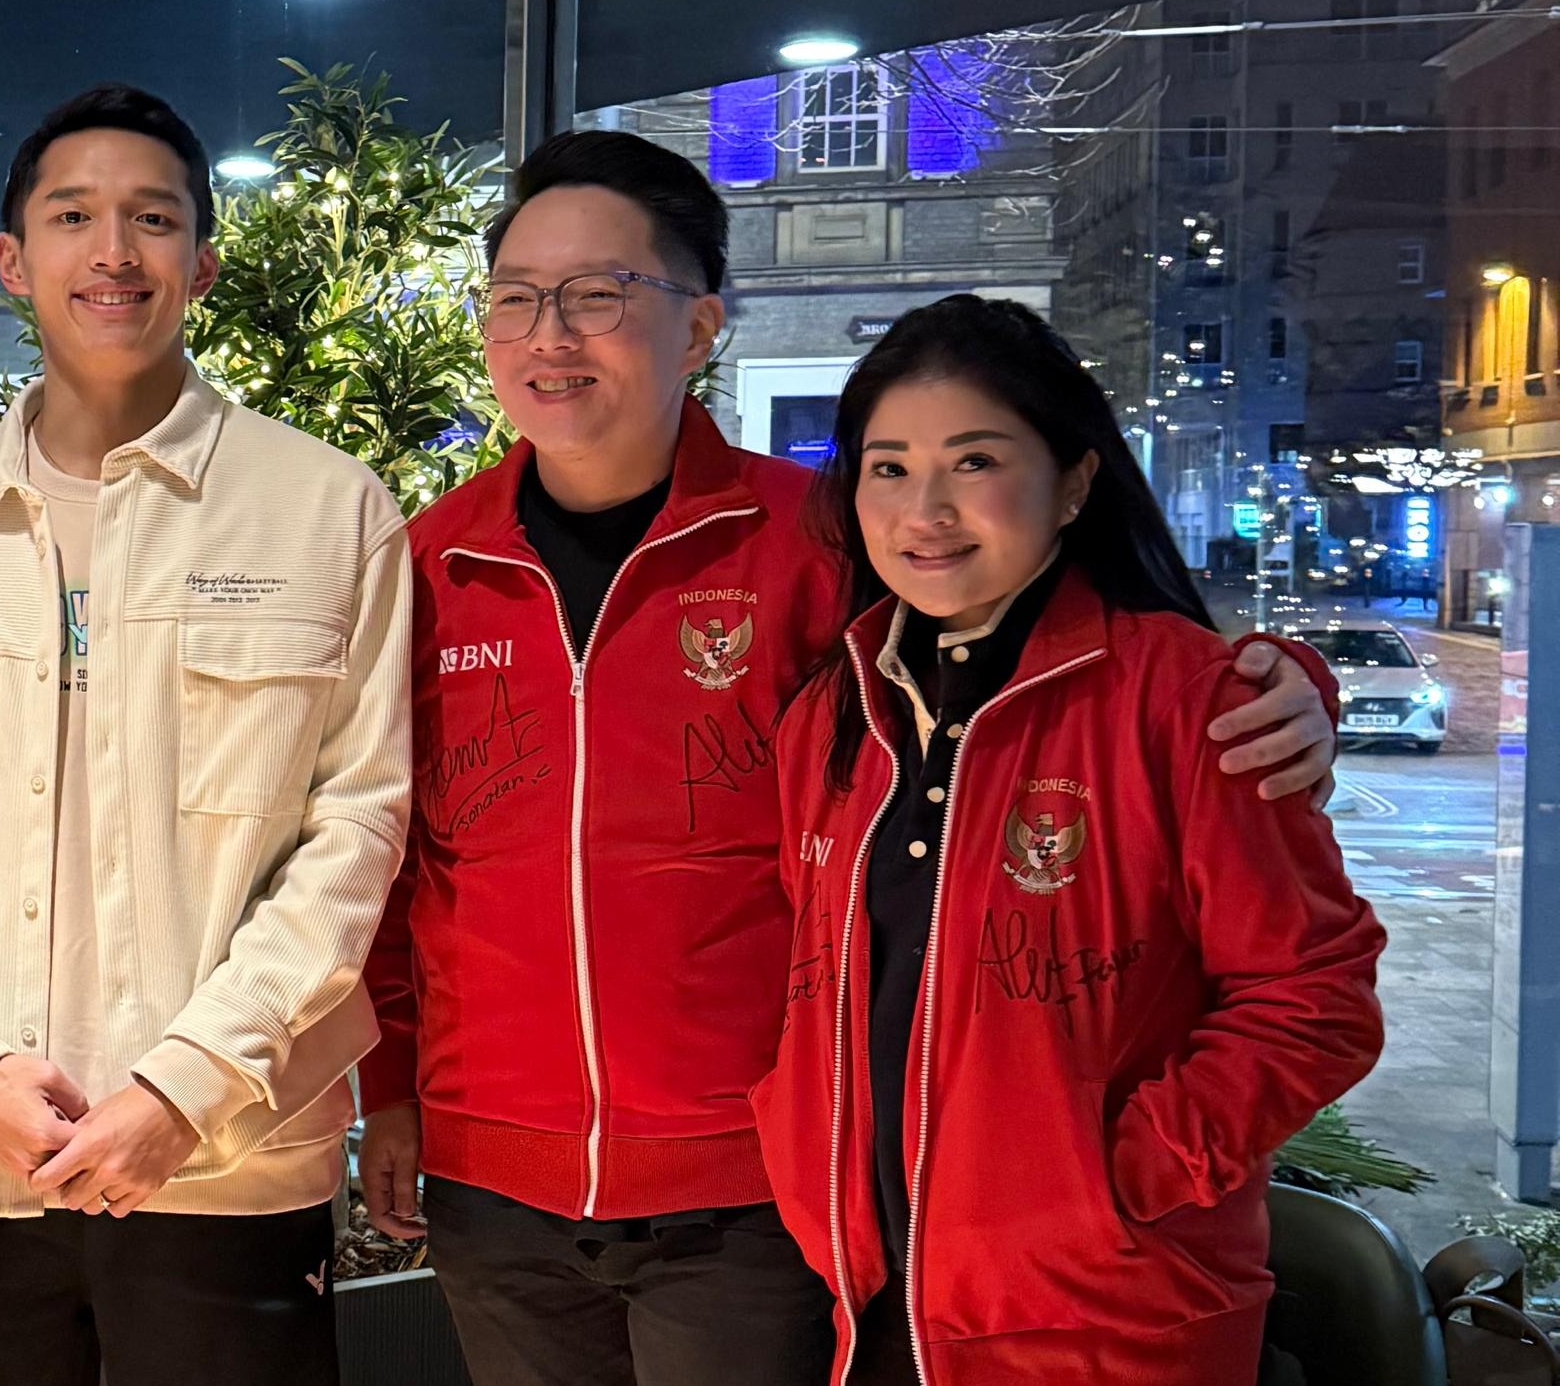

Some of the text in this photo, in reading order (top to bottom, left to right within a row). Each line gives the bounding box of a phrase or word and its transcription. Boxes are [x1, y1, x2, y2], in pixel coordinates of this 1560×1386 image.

[678, 588, 758, 606] INDONESIA
[460, 639, 513, 671] BNI
[1017, 776, 1092, 801] DONESIA
